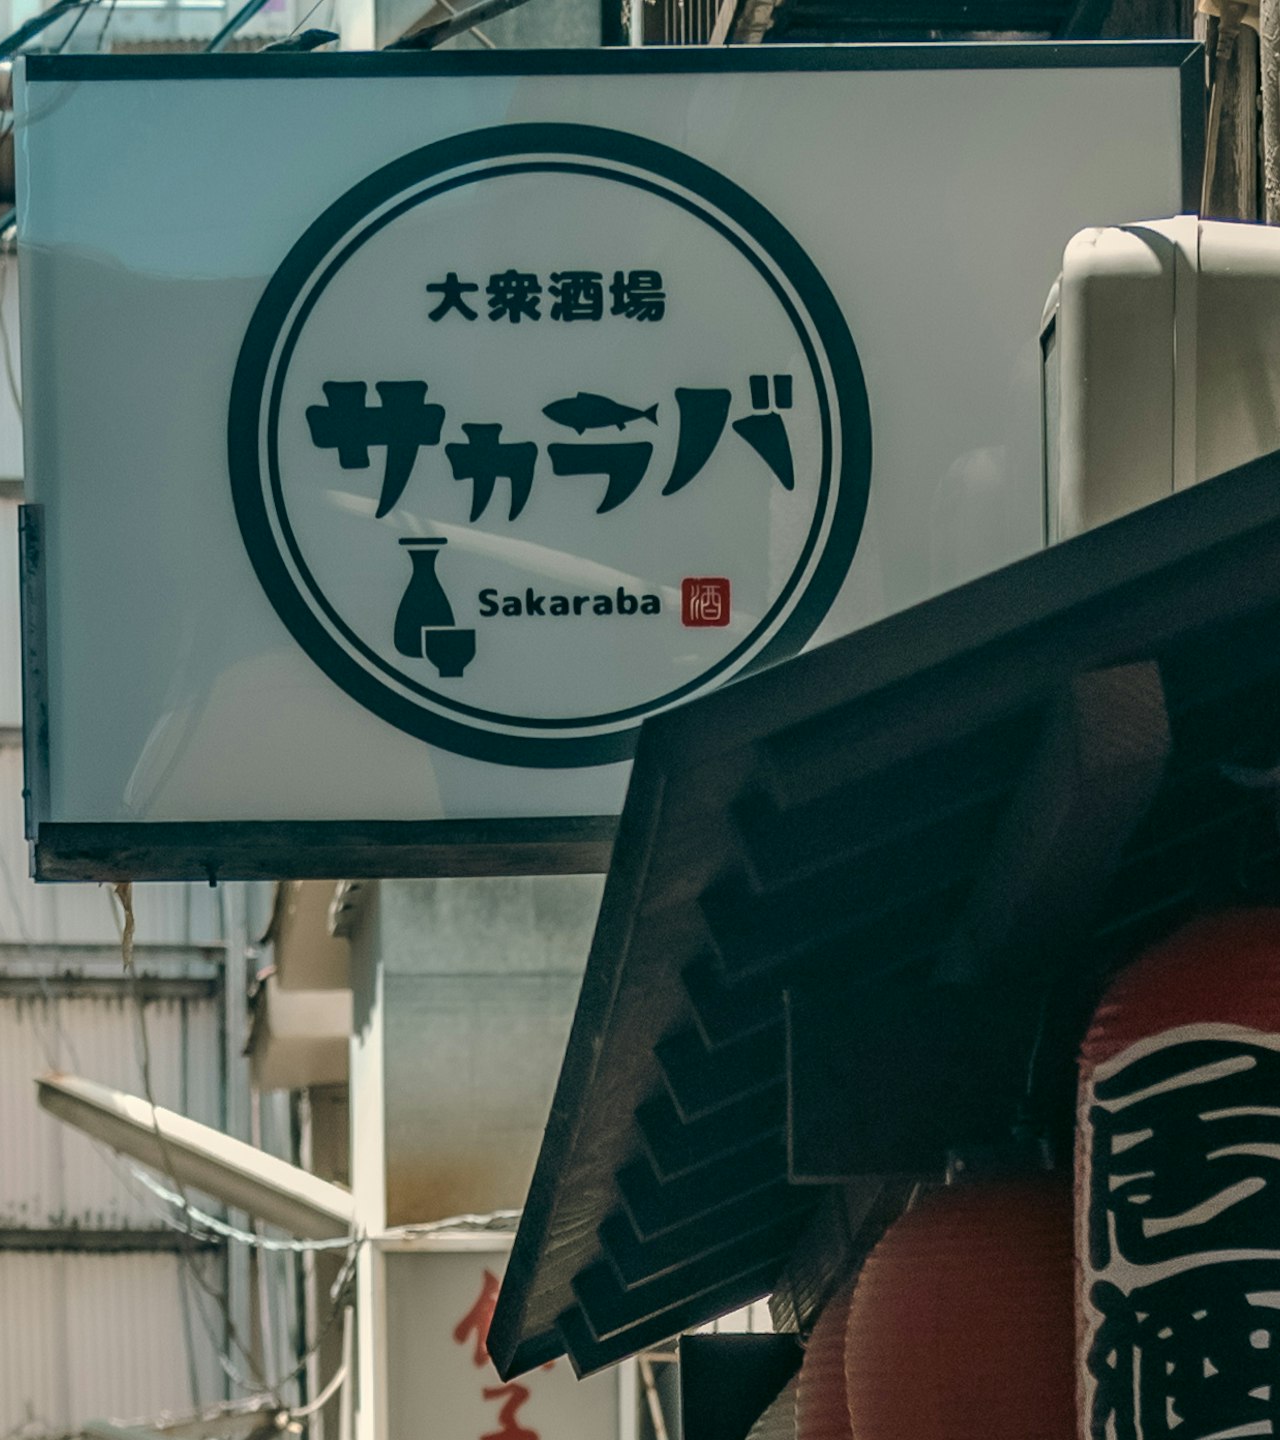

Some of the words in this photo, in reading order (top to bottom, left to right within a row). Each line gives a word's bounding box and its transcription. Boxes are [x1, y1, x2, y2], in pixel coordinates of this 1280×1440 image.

[425, 267, 667, 324] 大衆酒場
[303, 373, 797, 523] サカラバ
[476, 585, 663, 620] Sakaraba
